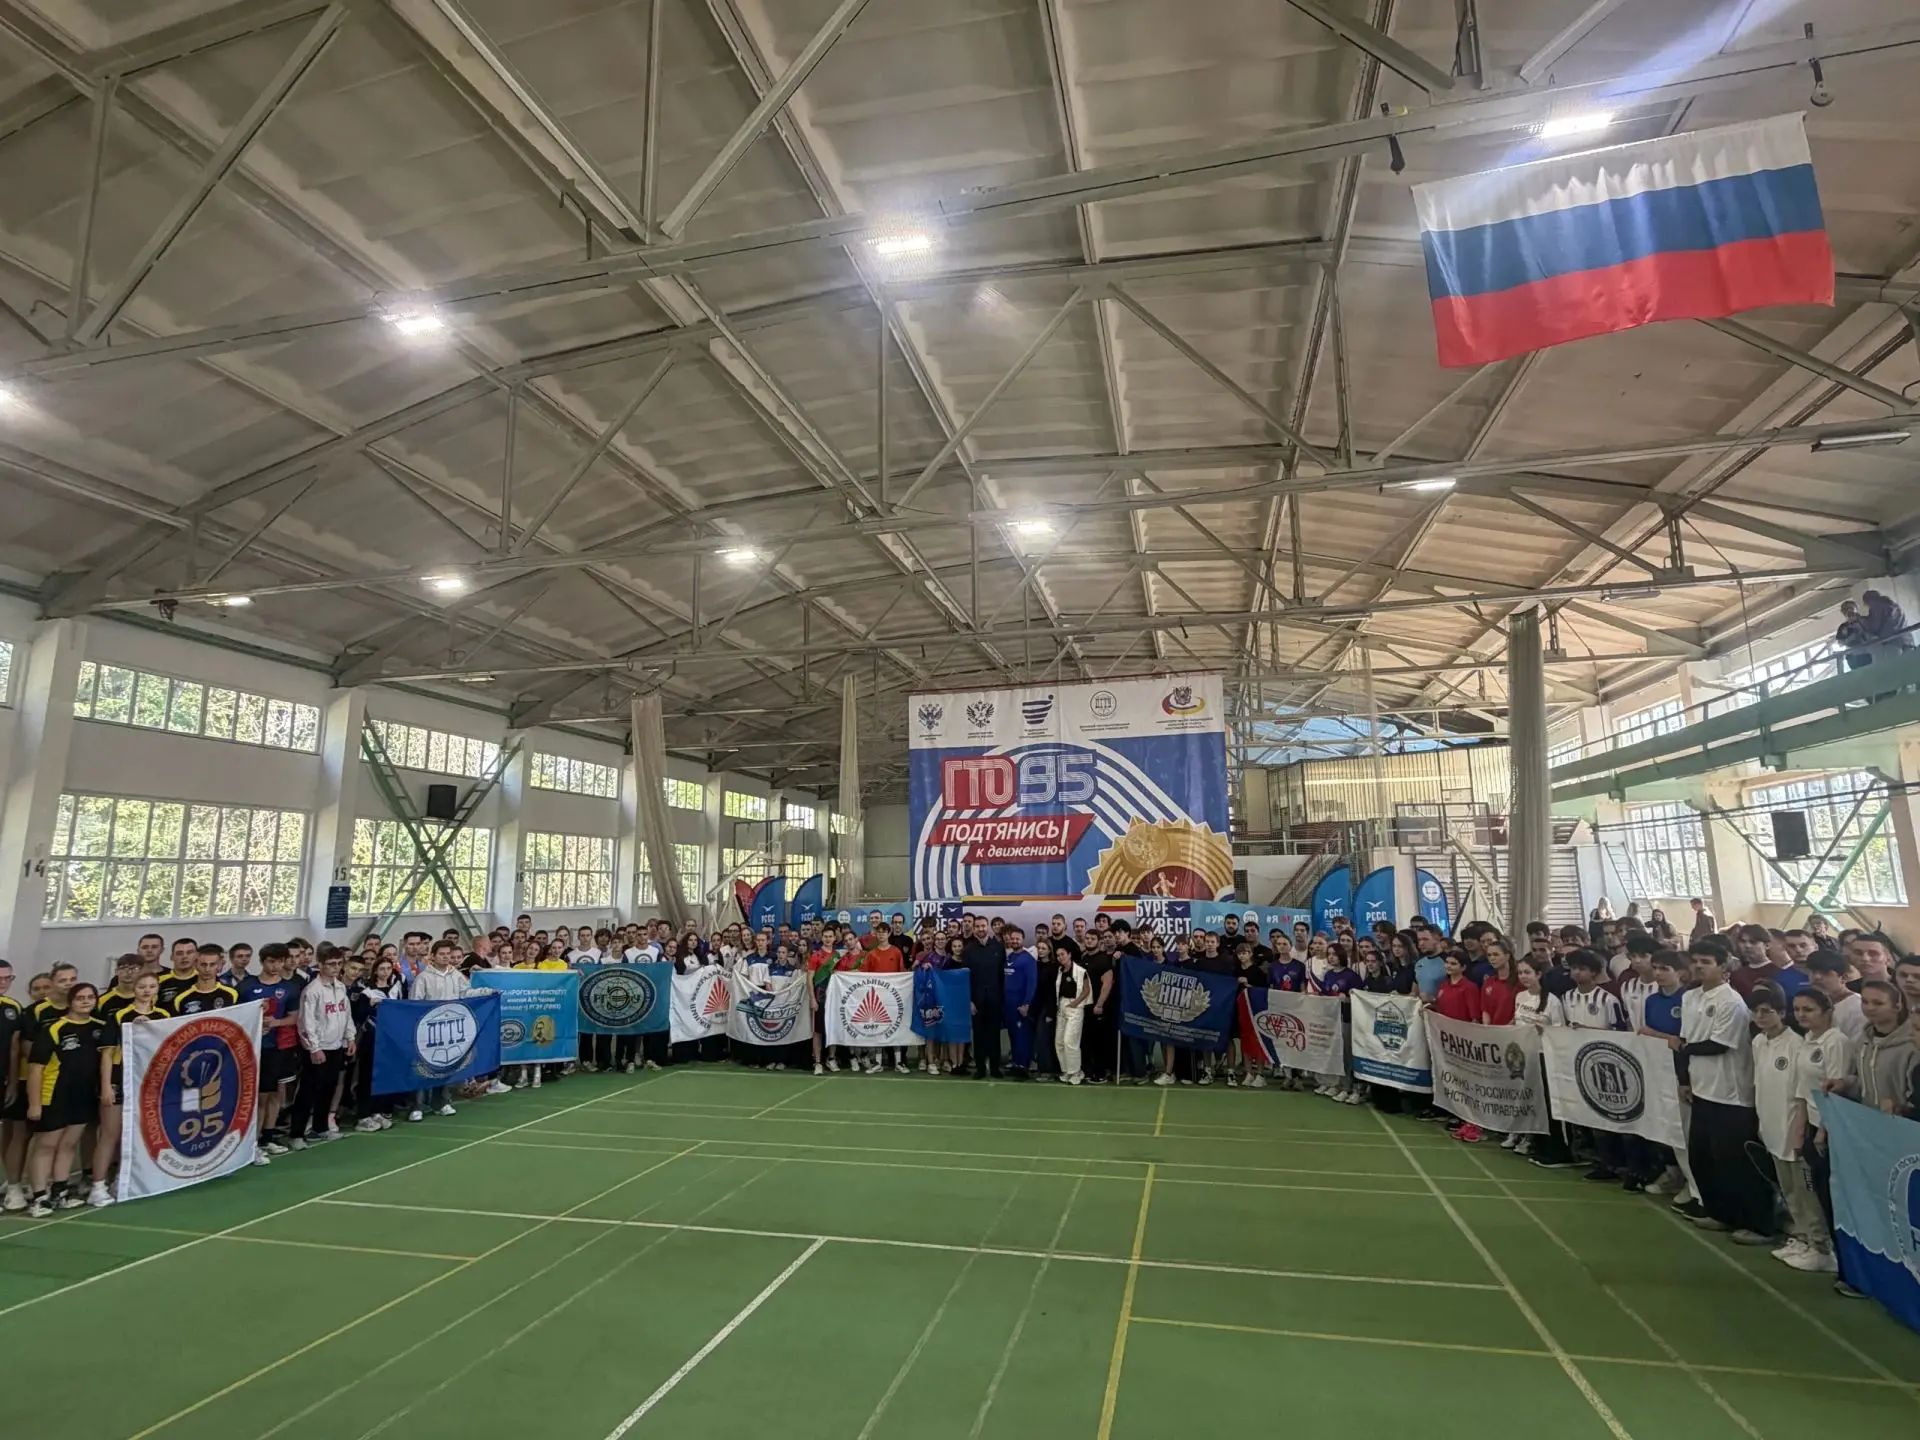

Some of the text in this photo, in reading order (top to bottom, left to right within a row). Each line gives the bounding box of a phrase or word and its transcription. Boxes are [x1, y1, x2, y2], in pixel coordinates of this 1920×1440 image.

[945, 753, 1095, 806] ГТО 95
[976, 848, 985, 858] к
[25, 860, 45, 877] 14
[335, 867, 347, 880] 15
[913, 901, 943, 917] БУРЕ
[1136, 900, 1170, 917] БУРЕ
[1158, 918, 1192, 934] ВЕСТ
[1158, 985, 1192, 1009] НПИ
[426, 1018, 466, 1048] ДГТУ
[1286, 1030, 1306, 1052] 30
[1441, 1031, 1501, 1064] РАНХиГС
[178, 1112, 225, 1144] 95
